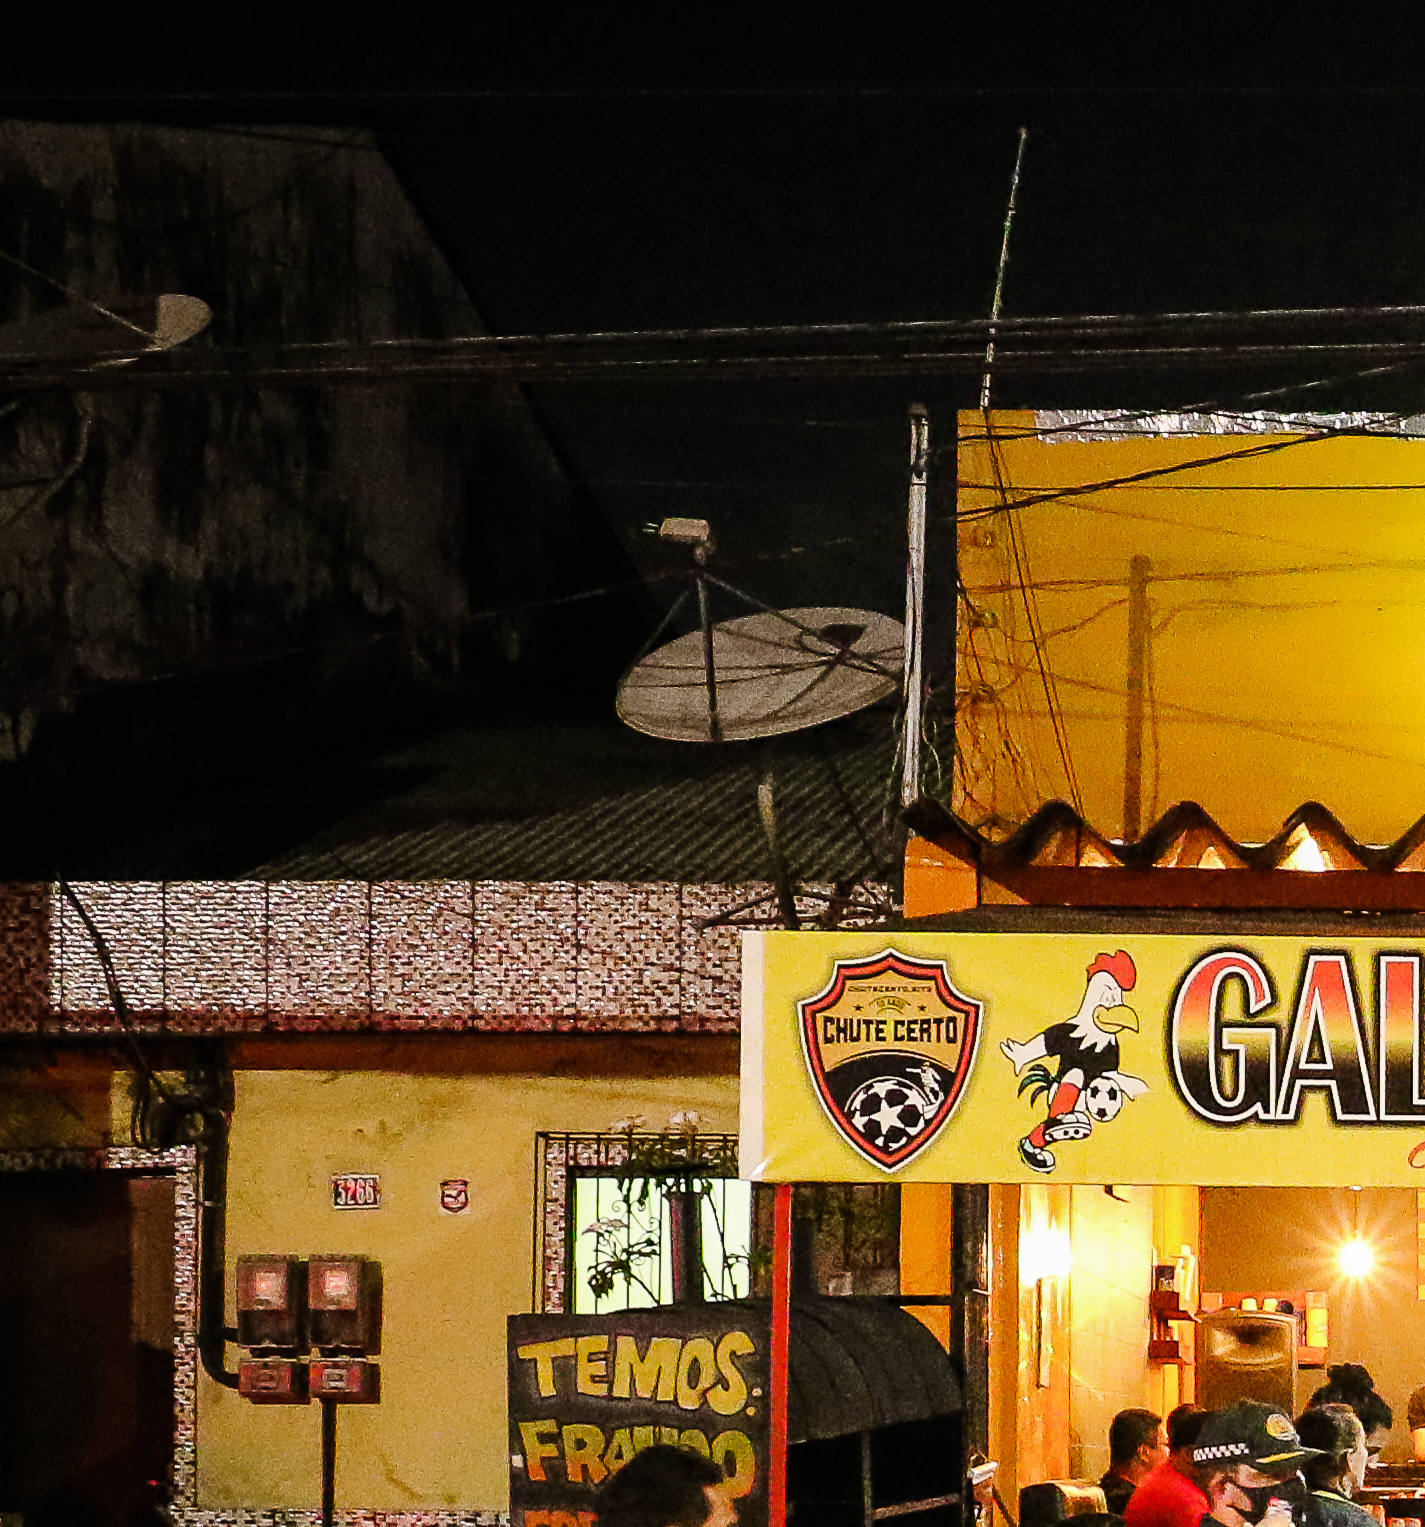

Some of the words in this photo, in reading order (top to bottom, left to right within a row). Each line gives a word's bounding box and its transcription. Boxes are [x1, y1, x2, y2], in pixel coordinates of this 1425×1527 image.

[823, 1015, 888, 1044] CHUTE
[893, 1015, 957, 1044] CERTO
[519, 1419, 756, 1500] FRAO
